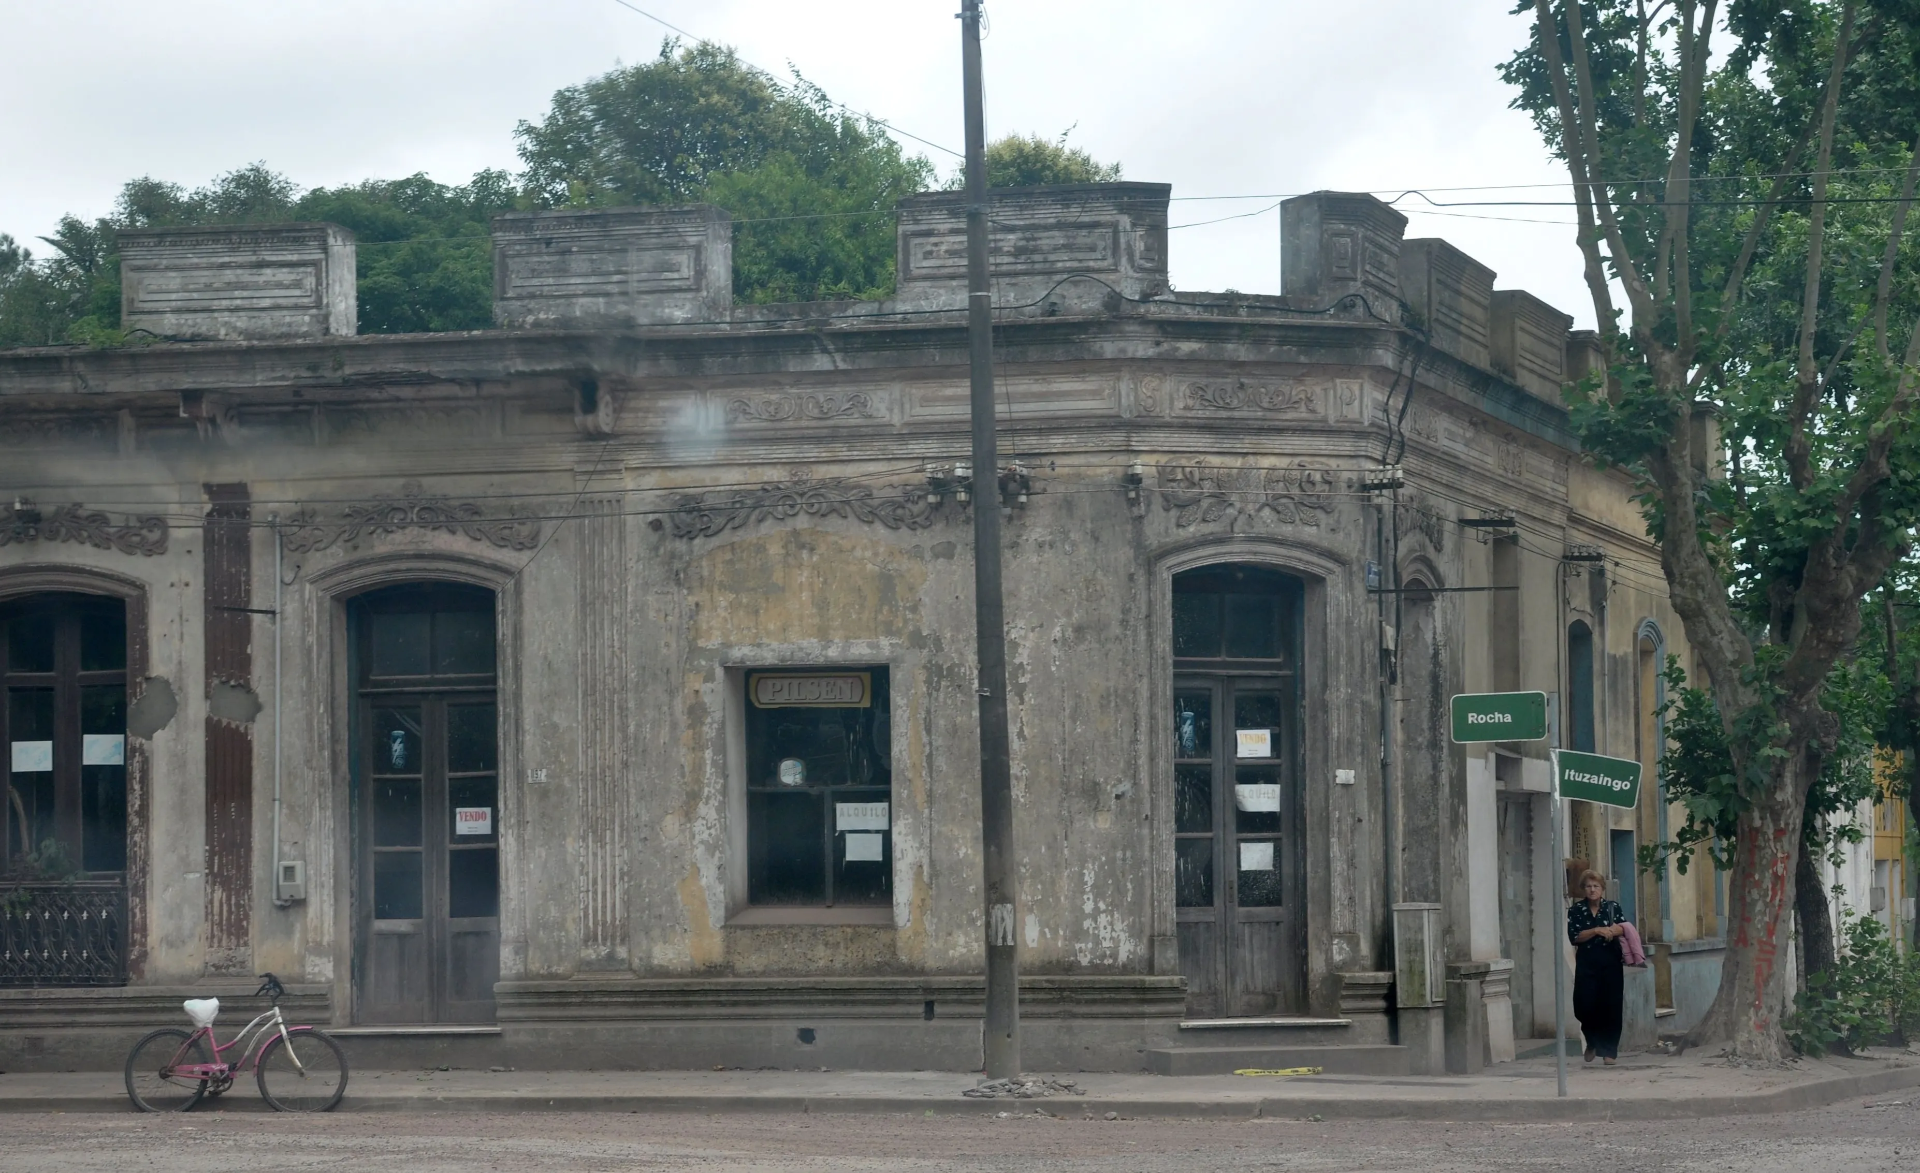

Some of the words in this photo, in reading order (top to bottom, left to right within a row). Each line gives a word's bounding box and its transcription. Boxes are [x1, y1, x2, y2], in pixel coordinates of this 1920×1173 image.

[767, 679, 854, 701] PILSEN
[1467, 711, 1512, 725] Rocha
[1239, 733, 1267, 745] VENDO
[1564, 768, 1634, 791] Ituzaingó
[458, 810, 487, 822] VENDO
